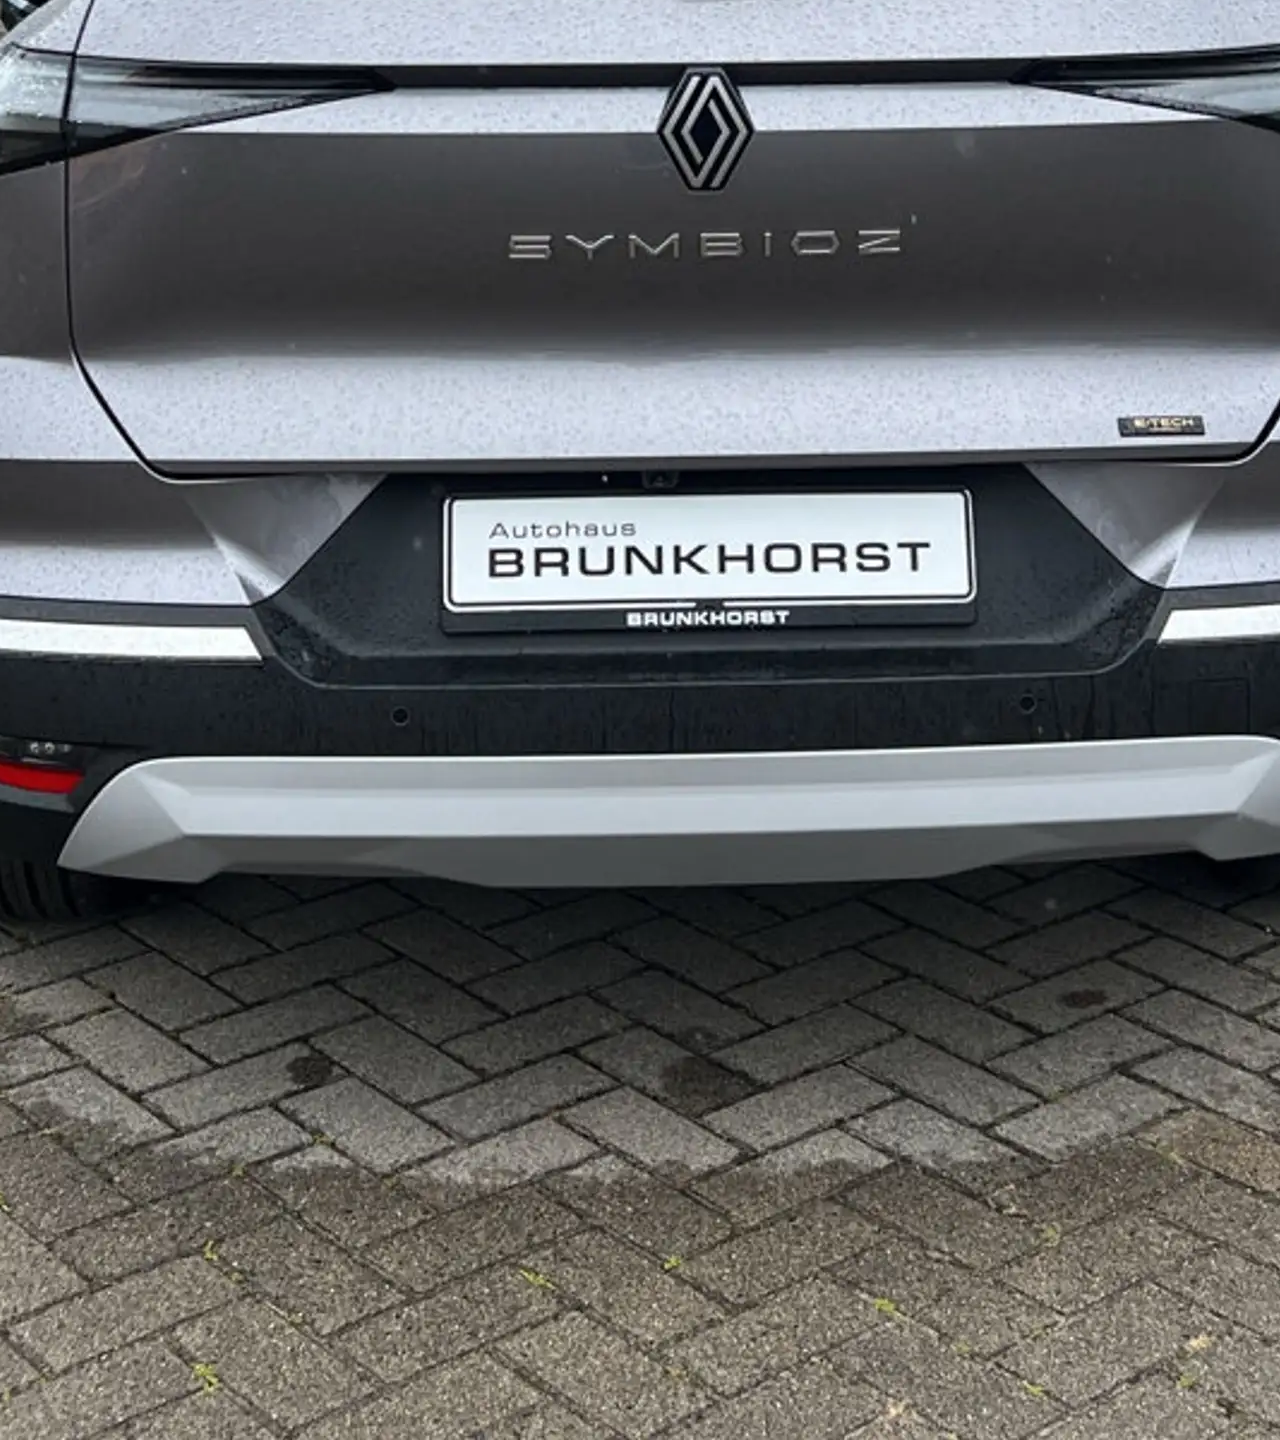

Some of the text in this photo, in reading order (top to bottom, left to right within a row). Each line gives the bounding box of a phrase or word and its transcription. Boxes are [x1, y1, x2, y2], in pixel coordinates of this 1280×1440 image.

[489, 520, 637, 539] Autohaus
[488, 542, 932, 578] BRUNKHORST
[627, 610, 790, 626] BRUNKHORST
